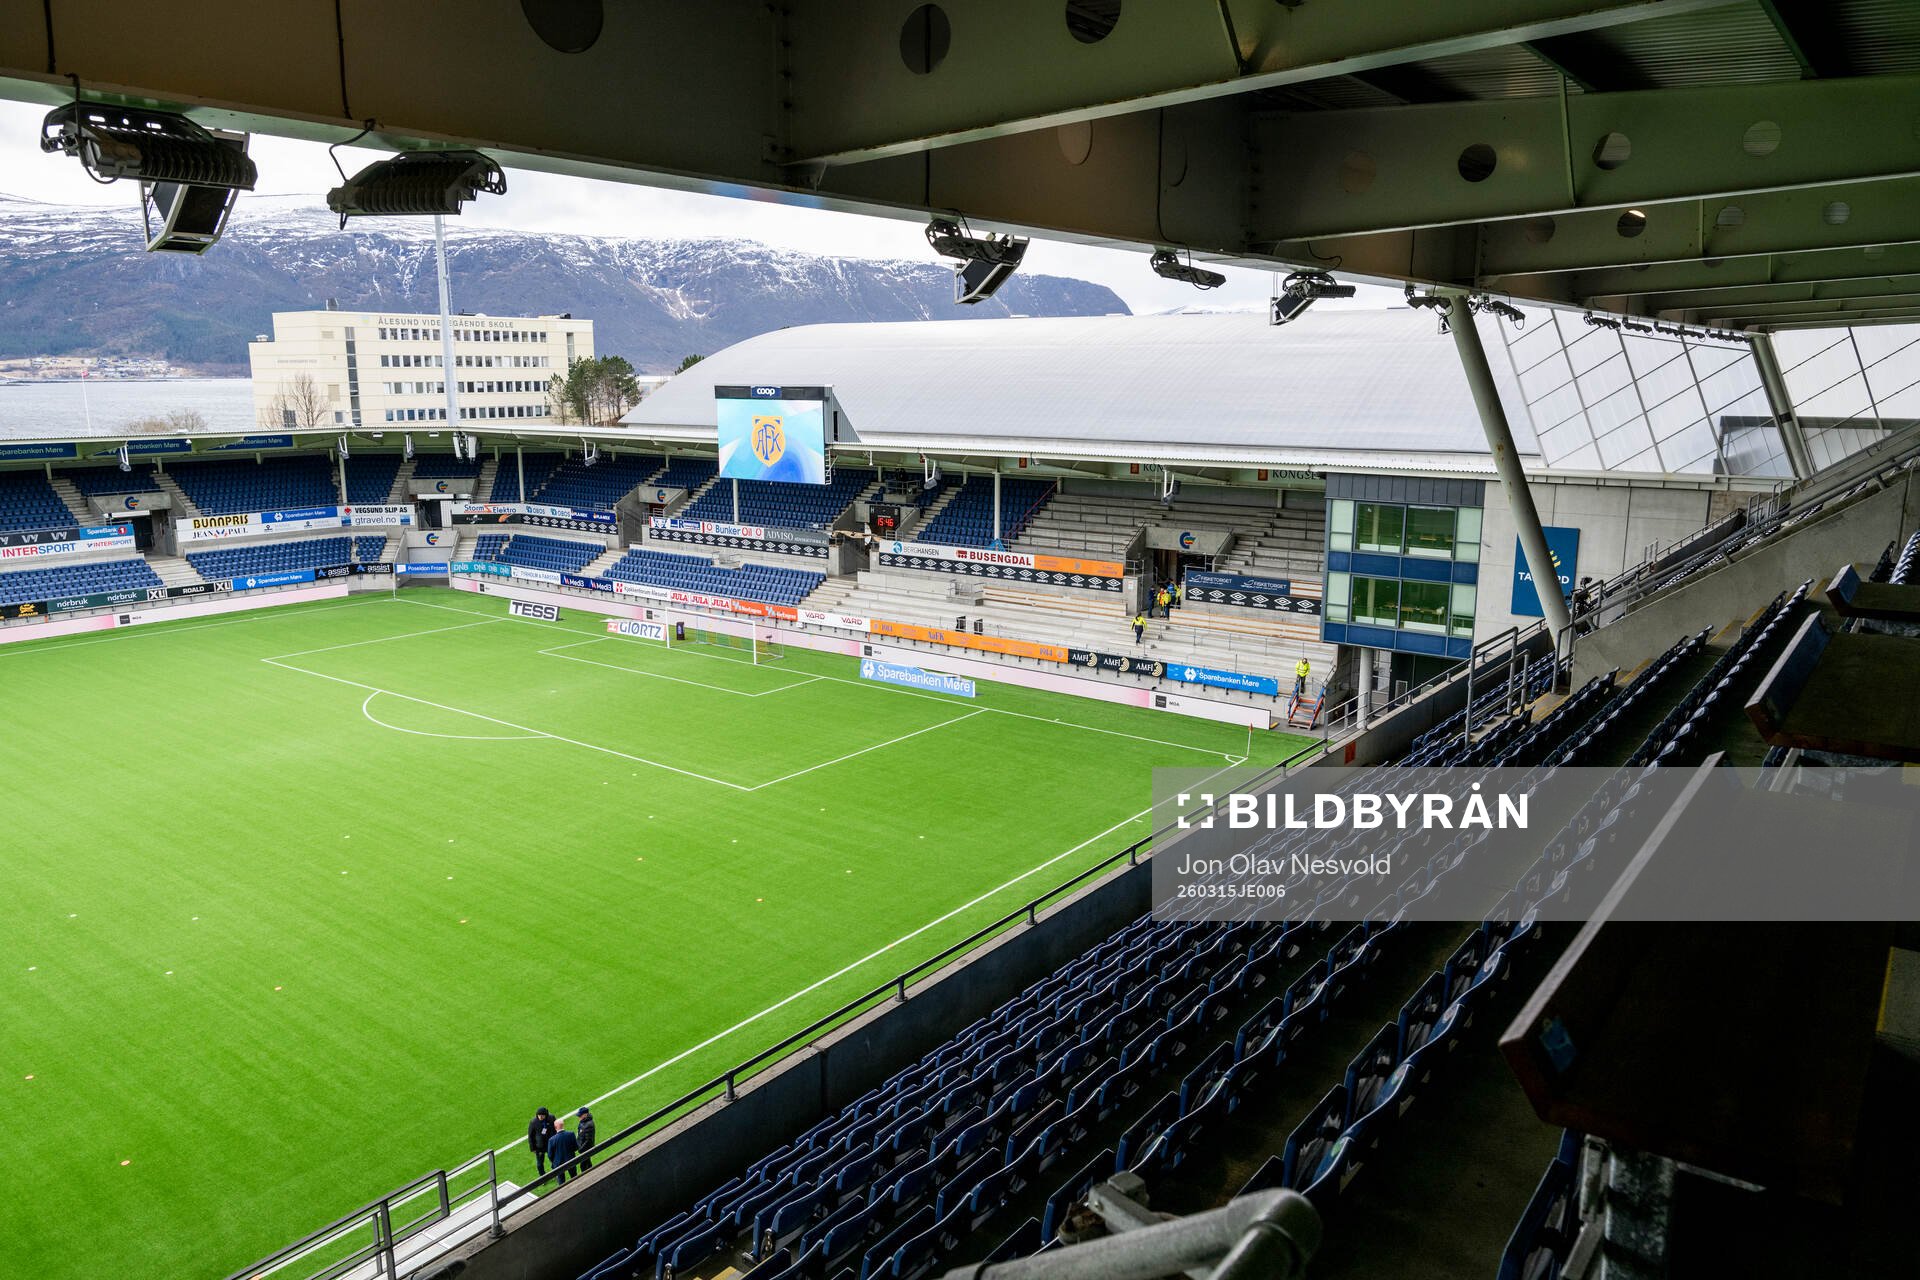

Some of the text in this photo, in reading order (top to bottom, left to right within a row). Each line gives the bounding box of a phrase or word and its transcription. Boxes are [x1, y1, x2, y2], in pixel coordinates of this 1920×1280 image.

[378, 315, 514, 329] ÅLESUND VIDEGÅENDE SKOLE
[756, 388, 776, 396] coop
[127, 443, 163, 451] parebanken
[464, 504, 484, 512] Storm
[192, 514, 248, 529] BUNNPRIS
[355, 516, 396, 524] gtravel.no
[878, 518, 894, 527] 15:46
[192, 528, 248, 540] JEAN PAUL
[716, 526, 752, 537] Bunker Oil
[766, 530, 794, 540] ADVISO
[93, 538, 132, 548] INTERSPORT
[2, 542, 76, 558] INTERSPORT
[904, 546, 940, 556] BERGHANSEN
[970, 551, 1032, 566] BUSENGDAL
[328, 566, 350, 576] assist
[368, 564, 390, 572] assist
[454, 562, 468, 572] DNB
[474, 562, 486, 572] DNB
[258, 574, 289, 584] Sparebanken
[570, 578, 584, 588] Med3
[182, 586, 205, 594] ROALD
[596, 582, 612, 590] Med3
[671, 592, 688, 602] JULA
[692, 596, 708, 605] JULA
[712, 598, 730, 608] JULA
[512, 602, 556, 620] TESS
[805, 612, 826, 620] VARD
[841, 617, 862, 626] VARD
[1072, 654, 1088, 662] AMFI
[1104, 658, 1120, 667] AMFI
[1136, 662, 1154, 672] AMFI
[877, 664, 970, 692] Sparebanken Møre
[1199, 672, 1260, 688] Sparebanken Møre
